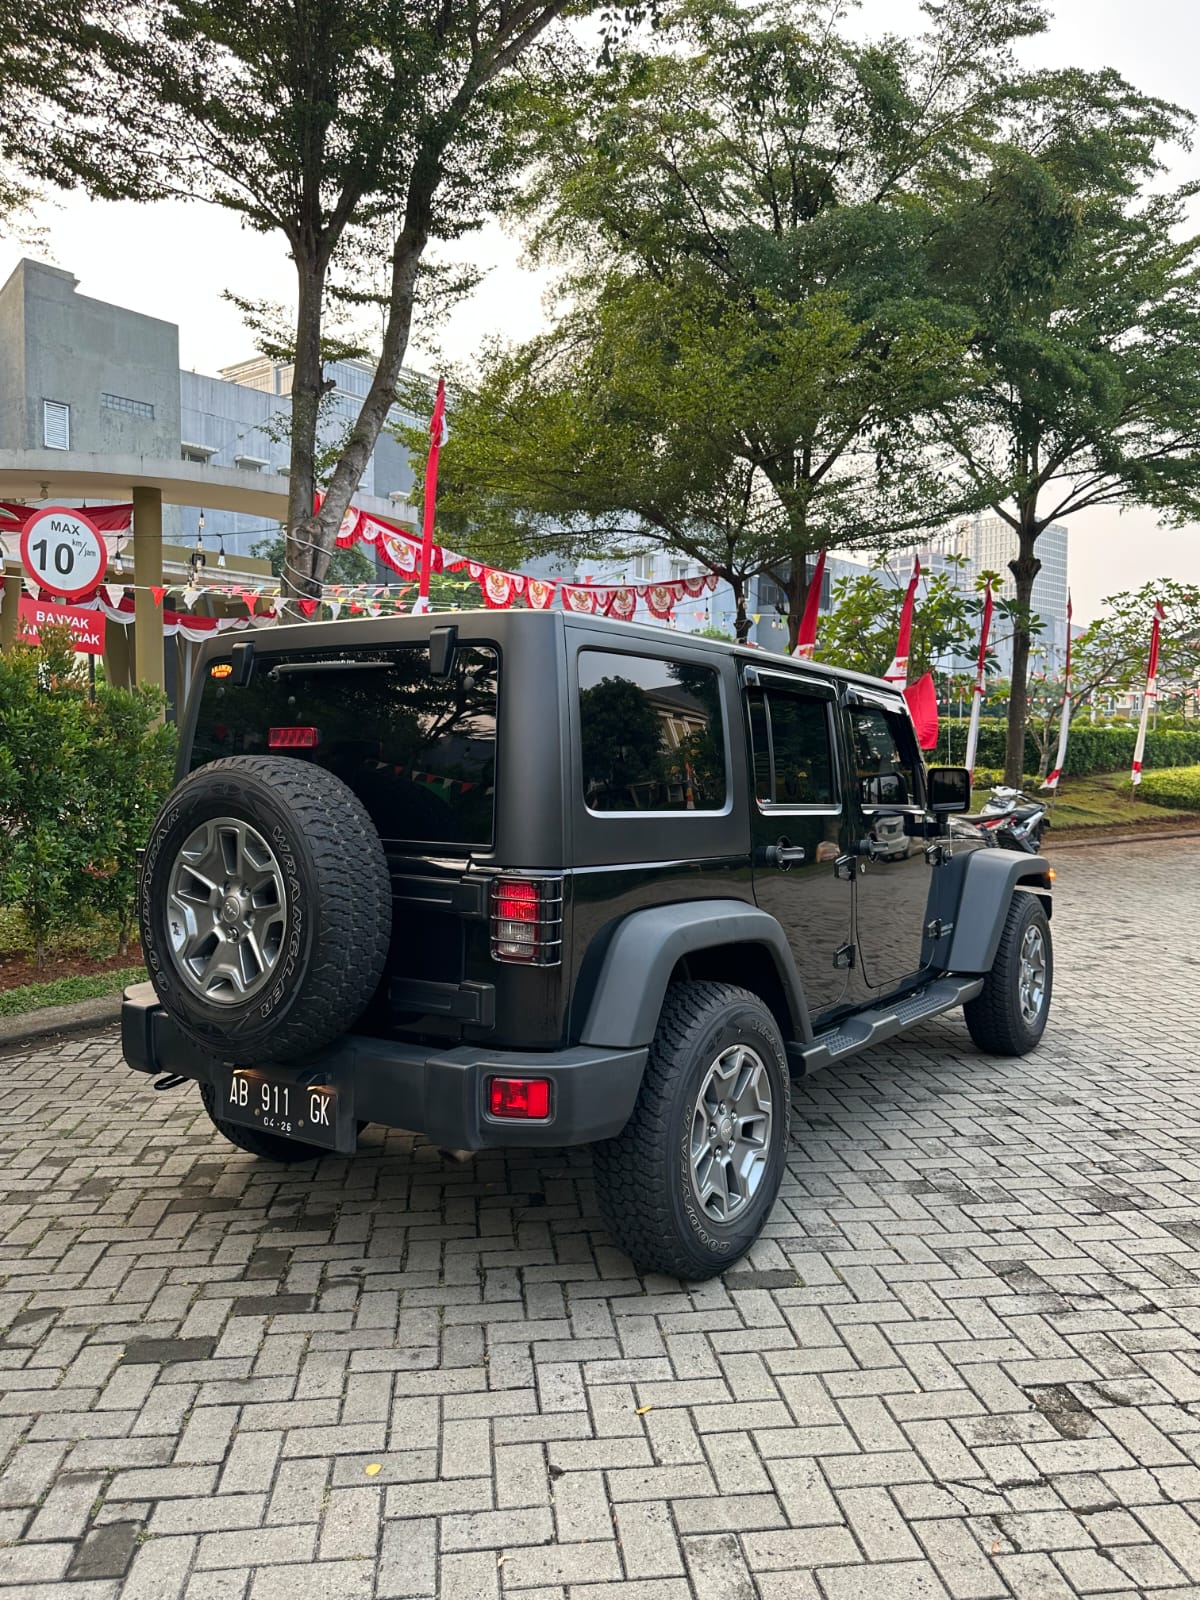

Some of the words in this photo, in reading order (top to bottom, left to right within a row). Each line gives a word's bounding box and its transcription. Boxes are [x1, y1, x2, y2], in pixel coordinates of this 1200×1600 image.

[50, 520, 80, 536] MAX
[32, 539, 74, 575] 10
[72, 538, 96, 558] km/jam
[36, 610, 89, 629] BANYAK
[261, 825, 302, 1019] WRANGLER
[229, 1076, 249, 1106] AB
[261, 1083, 289, 1116] 911
[310, 1094, 330, 1126] GK
[679, 1104, 731, 1254] GOODYEAR
